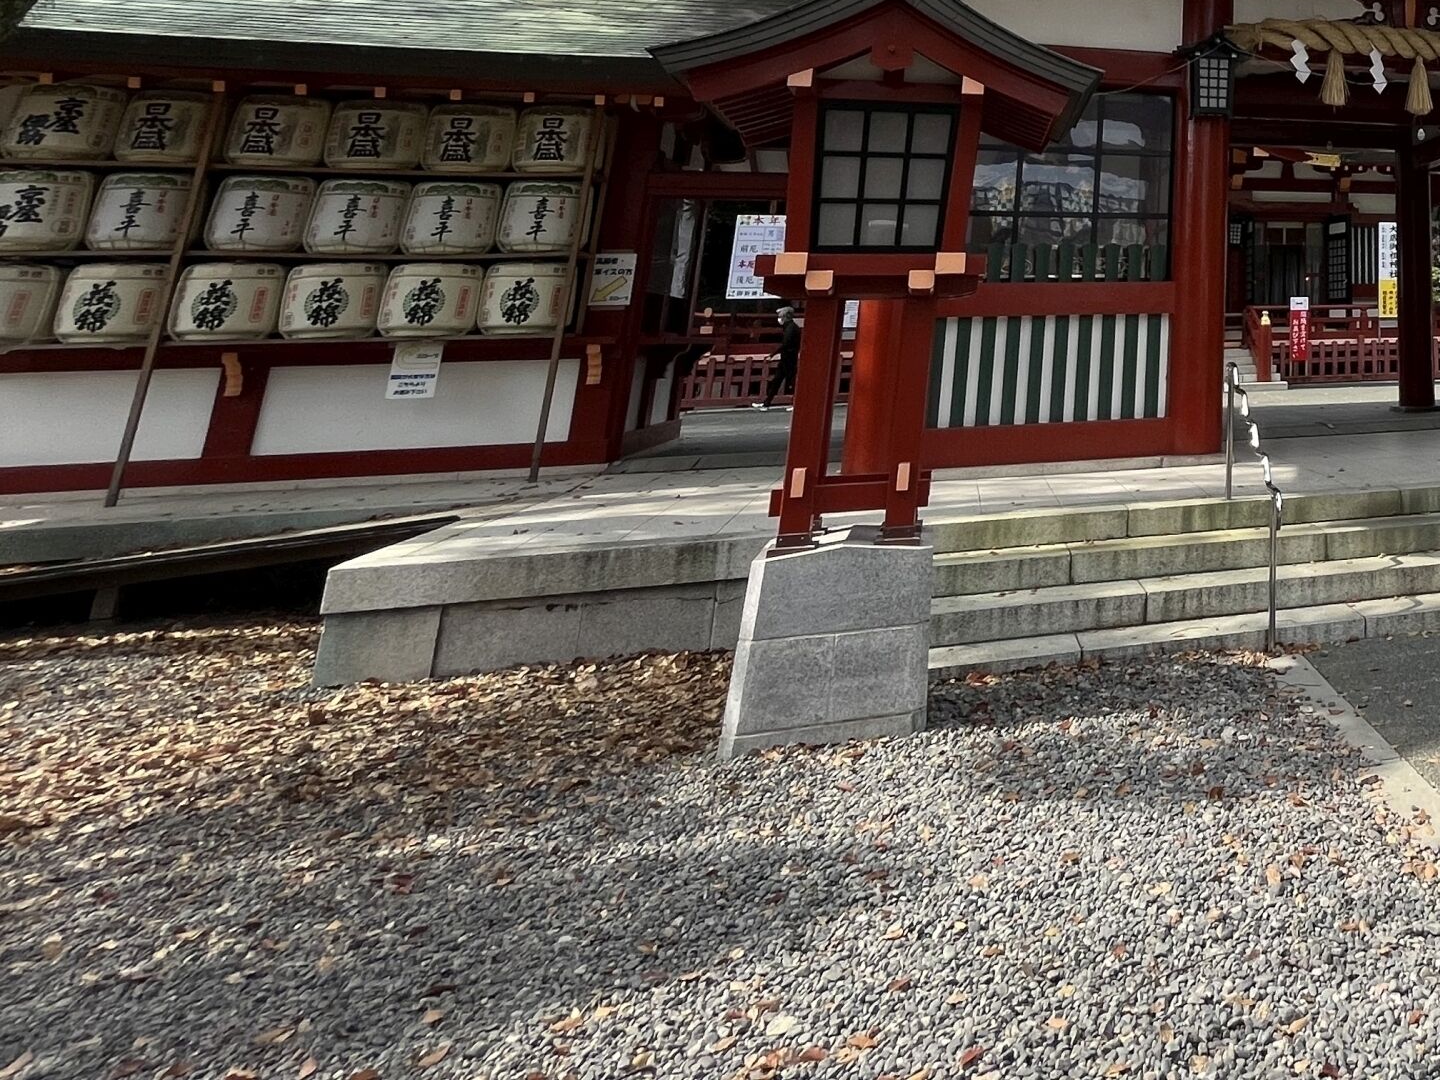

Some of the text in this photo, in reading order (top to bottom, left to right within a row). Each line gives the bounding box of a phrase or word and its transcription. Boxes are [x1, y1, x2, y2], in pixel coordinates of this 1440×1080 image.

[131, 103, 173, 150] 日本盛
[240, 108, 281, 155] 日本盛
[347, 112, 385, 158] 日本盛
[440, 117, 478, 162] 日本盛
[533, 117, 567, 162] 日本盛
[114, 190, 152, 237] 喜平
[230, 192, 266, 240] 喜平
[333, 194, 367, 241] 喜平
[431, 196, 460, 242] 喜平
[525, 197, 556, 241] 喜平
